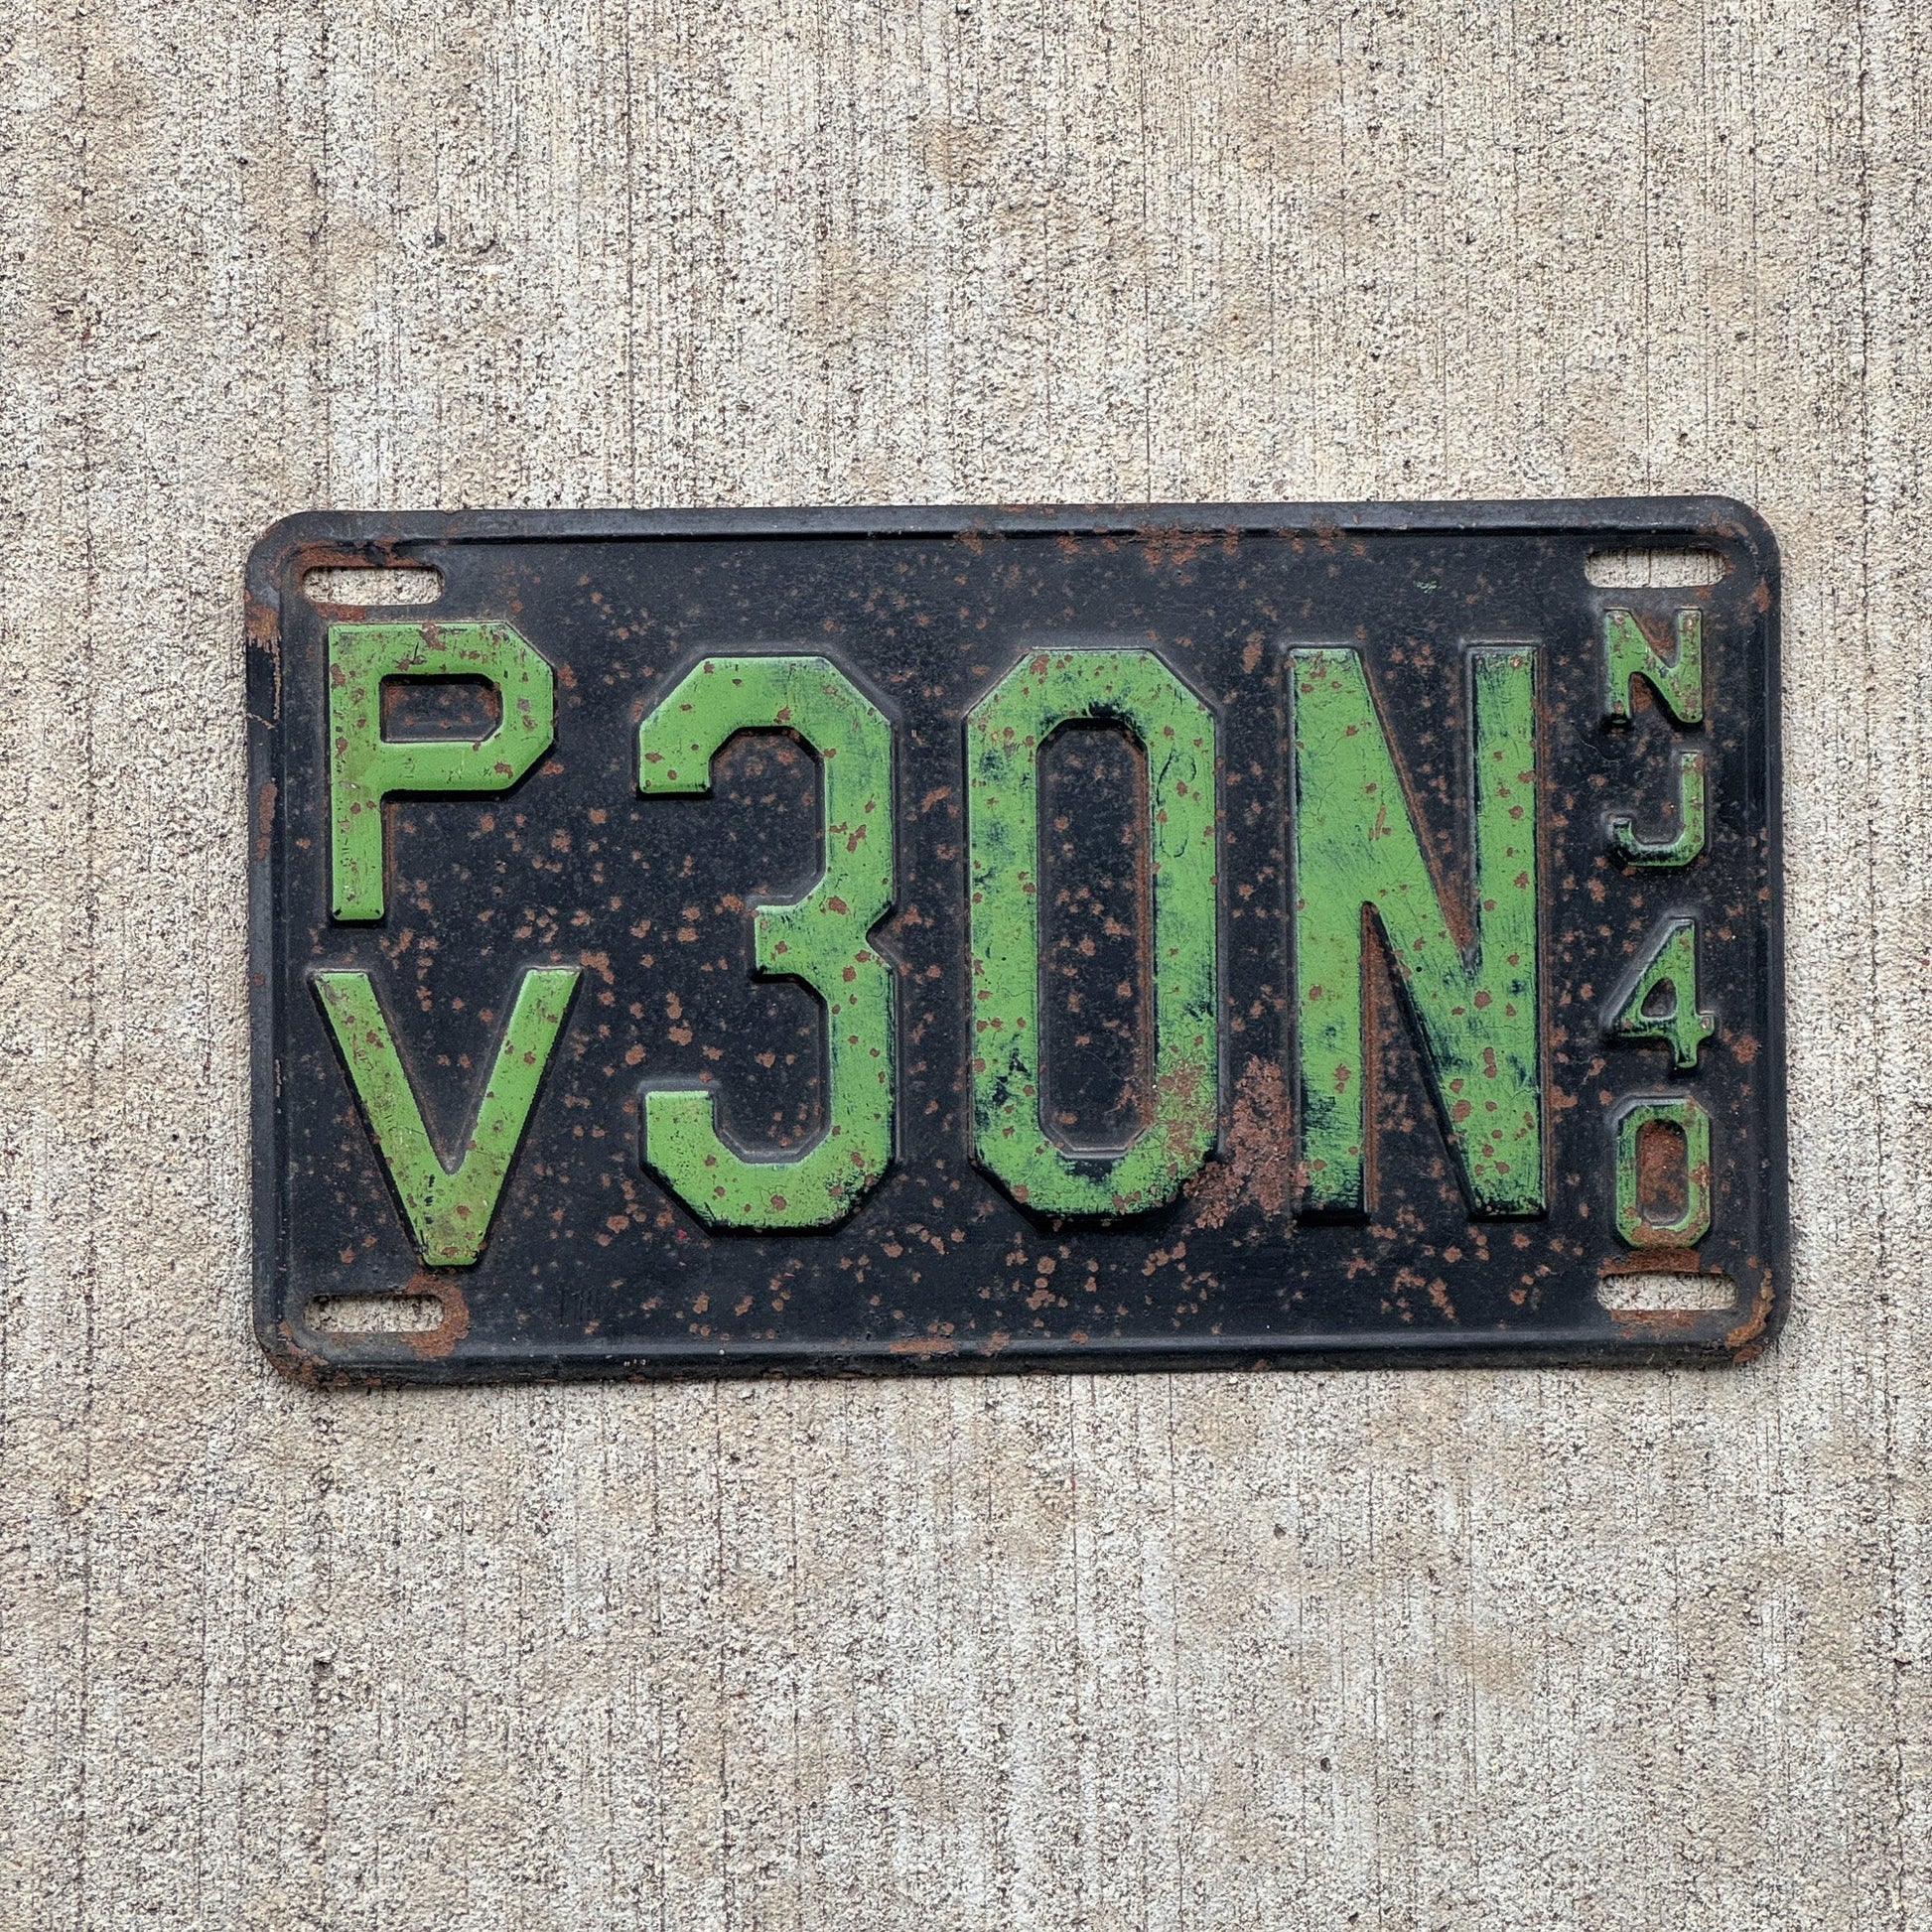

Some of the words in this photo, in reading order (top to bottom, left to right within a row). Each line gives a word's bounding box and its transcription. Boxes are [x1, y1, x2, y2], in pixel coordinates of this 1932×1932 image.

[312, 621, 580, 1268] PV
[636, 644, 1546, 1231] 30N
[1602, 607, 1705, 868] NJ
[1606, 915, 1716, 1248] 40
